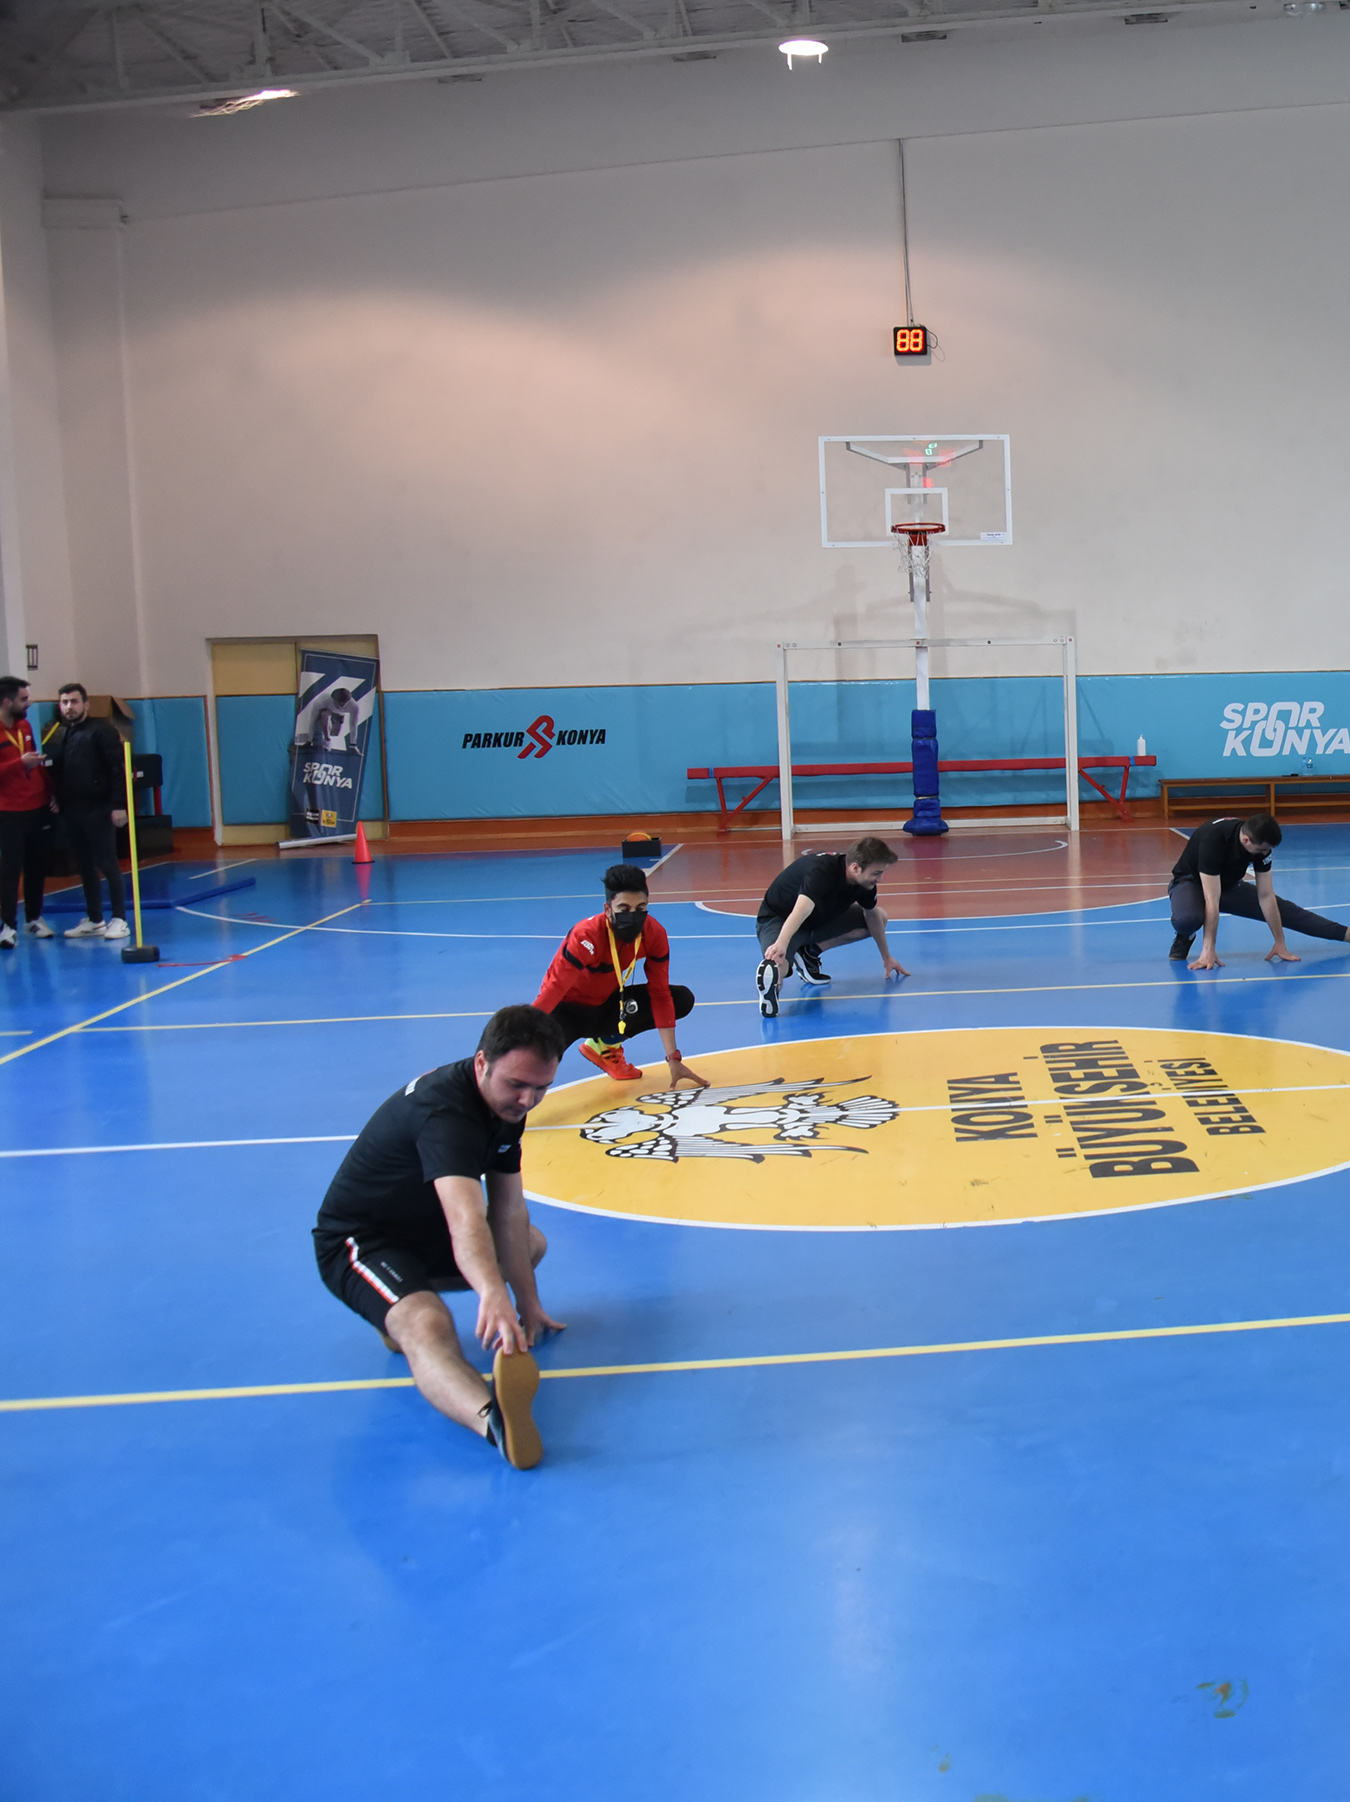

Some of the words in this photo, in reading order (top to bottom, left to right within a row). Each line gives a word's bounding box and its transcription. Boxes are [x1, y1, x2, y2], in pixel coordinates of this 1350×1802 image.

[896, 328, 924, 352] 88
[1219, 701, 1325, 740] SPOR
[462, 732, 525, 749] PARKUR
[556, 729, 606, 746] KONYA
[303, 762, 343, 777] SPOR
[303, 770, 352, 789] KONYA
[947, 1072, 1038, 1142] KONYA
[1023, 1040, 1200, 1178] BÜYÜKŞEHİR
